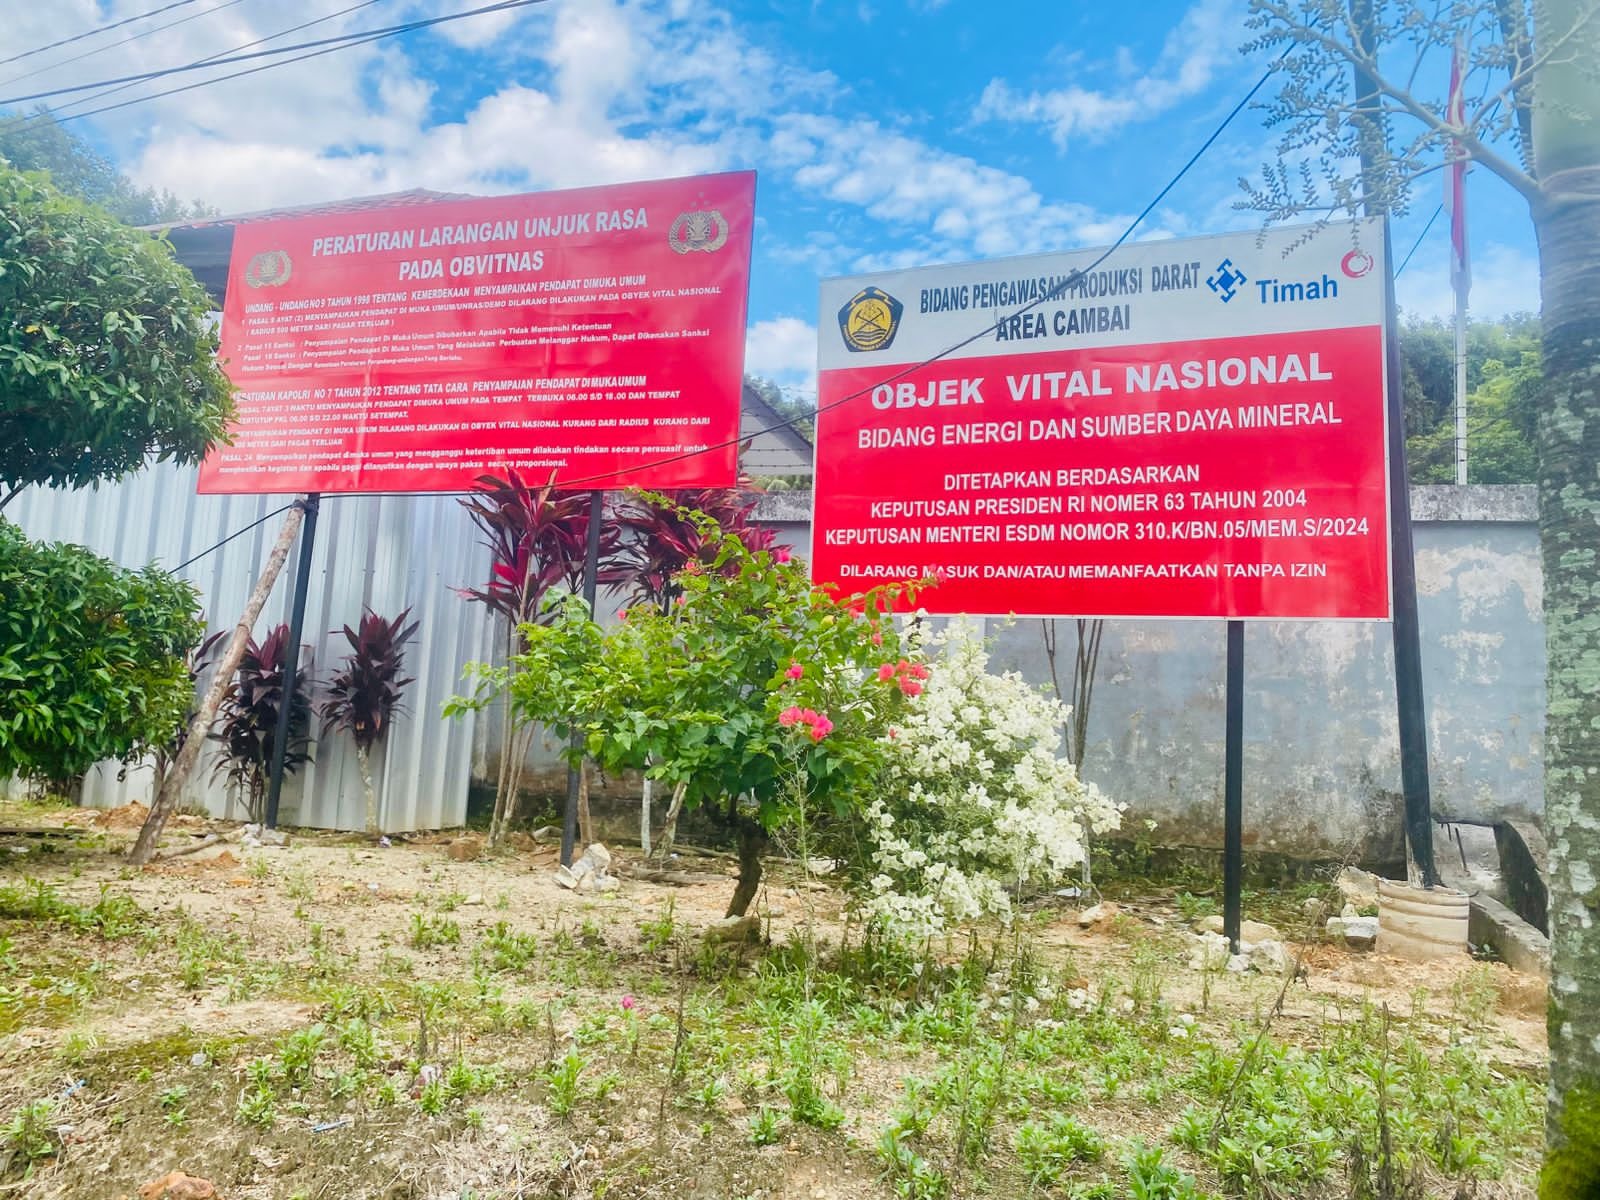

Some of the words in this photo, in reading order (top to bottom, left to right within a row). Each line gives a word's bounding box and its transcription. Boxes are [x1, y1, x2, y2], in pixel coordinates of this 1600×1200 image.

[312, 230, 414, 256] PERATURAN
[419, 221, 519, 247] LARANGAN
[524, 213, 591, 239] UNJUK
[596, 207, 648, 232] RASA
[399, 259, 443, 281] PADA
[449, 250, 545, 277] OBVITNAS
[245, 303, 274, 314] UNDANG
[327, 297, 352, 308] TAHUN
[372, 291, 407, 304] TENTANG
[411, 287, 470, 300] KEMERDEKAAN
[474, 282, 537, 296] MENYAMPAIKAN
[539, 279, 581, 291] PENDAPAT
[583, 277, 617, 289] DIMUKA
[619, 275, 646, 286] UMUM
[920, 285, 969, 314] BIDANG
[972, 275, 1066, 310] PENGAWASAN
[1151, 262, 1201, 292] DARAT
[1255, 273, 1338, 304] Timah
[305, 310, 360, 321] MENYAMPAIKAN
[361, 307, 397, 317] PENDAPAT
[409, 305, 430, 314] MUKA
[508, 297, 548, 307] DILARANG
[549, 294, 597, 304] DILAKUKAN
[598, 293, 619, 302] PADA
[621, 291, 649, 300] OBYEK
[652, 289, 676, 298] VITAL
[678, 286, 722, 296] NASIONAL
[508, 326, 529, 335] Tidak
[572, 322, 612, 332] Ketentuan
[996, 312, 1047, 342] AREA
[1053, 304, 1130, 337] CAMBAI
[437, 342, 454, 351] Yang
[499, 338, 537, 347] Perbuatan
[538, 335, 580, 346] Melanggar
[612, 332, 636, 341] Dapat
[638, 330, 679, 339] Dikenakan
[682, 328, 710, 337] Sanksi
[277, 390, 311, 401] KAPOLRI
[314, 389, 326, 399] NO
[334, 387, 361, 398] TAHUN
[362, 386, 381, 396] 2012
[383, 385, 421, 395] TENTANG
[424, 383, 443, 394] TATA
[445, 382, 468, 393] CARA
[473, 378, 532, 392] PENYAMPAIAN
[535, 377, 581, 389] PENDAPAT
[617, 375, 647, 387] UMUM
[871, 377, 985, 410] OBJEK
[1006, 368, 1113, 401] VITAL
[1126, 352, 1334, 394] NASIONAL
[374, 399, 412, 408] PENDAPAT
[445, 397, 469, 405] UMUM
[470, 395, 490, 404] PADA
[493, 394, 522, 403] TEMPAT
[527, 392, 565, 402] TERBUKA
[628, 391, 646, 399] DAN
[648, 390, 681, 398] TEMPAT
[378, 424, 415, 433] DILARANG
[417, 422, 459, 431] DILAKUKAN
[461, 422, 469, 430] DI
[498, 420, 520, 428] VITAL
[522, 420, 560, 428] NASIONAL
[562, 419, 596, 427] KURANG
[598, 418, 617, 426] DARI
[619, 418, 649, 426] RADIUS
[653, 417, 688, 425] KURANG
[690, 416, 710, 424] DARI
[858, 426, 935, 449] BIDANG
[942, 421, 1022, 446] ENERGI
[1029, 417, 1076, 441] DAN
[1081, 412, 1171, 439] SUMBER
[1175, 407, 1234, 433] DAYA
[1238, 401, 1342, 429] MINERAL
[395, 450, 413, 459] yang
[415, 449, 463, 459] mengganggu
[465, 447, 505, 456] ketertiban
[507, 447, 531, 455] umum
[533, 446, 572, 455] dilakukan
[574, 445, 609, 454] tindakan
[642, 445, 681, 456] persuasif
[684, 444, 709, 453] untuk
[406, 461, 433, 471] dengan
[944, 471, 1052, 491] DITETAPKAN
[1056, 464, 1200, 487] BERDASARKAN
[871, 498, 970, 518] KEPUTUSAN
[975, 496, 1062, 516] PRESIDEN
[1068, 495, 1086, 513] RI
[1090, 493, 1158, 513] NOMER
[1164, 492, 1185, 511] 63
[1190, 491, 1256, 510] TAHUN
[1262, 489, 1307, 508] 2004
[825, 527, 921, 545] KEPUTUSAN
[926, 525, 1001, 543] MENTERI
[1005, 524, 1055, 542] ESDM
[1059, 521, 1129, 541] NOMOR
[1135, 517, 1369, 541] 310.K/BN.05/MEM.S/2024
[840, 564, 918, 579] DILARANG
[922, 564, 980, 579] MASUK
[984, 564, 1066, 579] DAN/ATAU
[1068, 563, 1218, 579] MEMANFAATKAN
[1223, 563, 1286, 578] TANPA
[1291, 562, 1327, 578] IZIN
